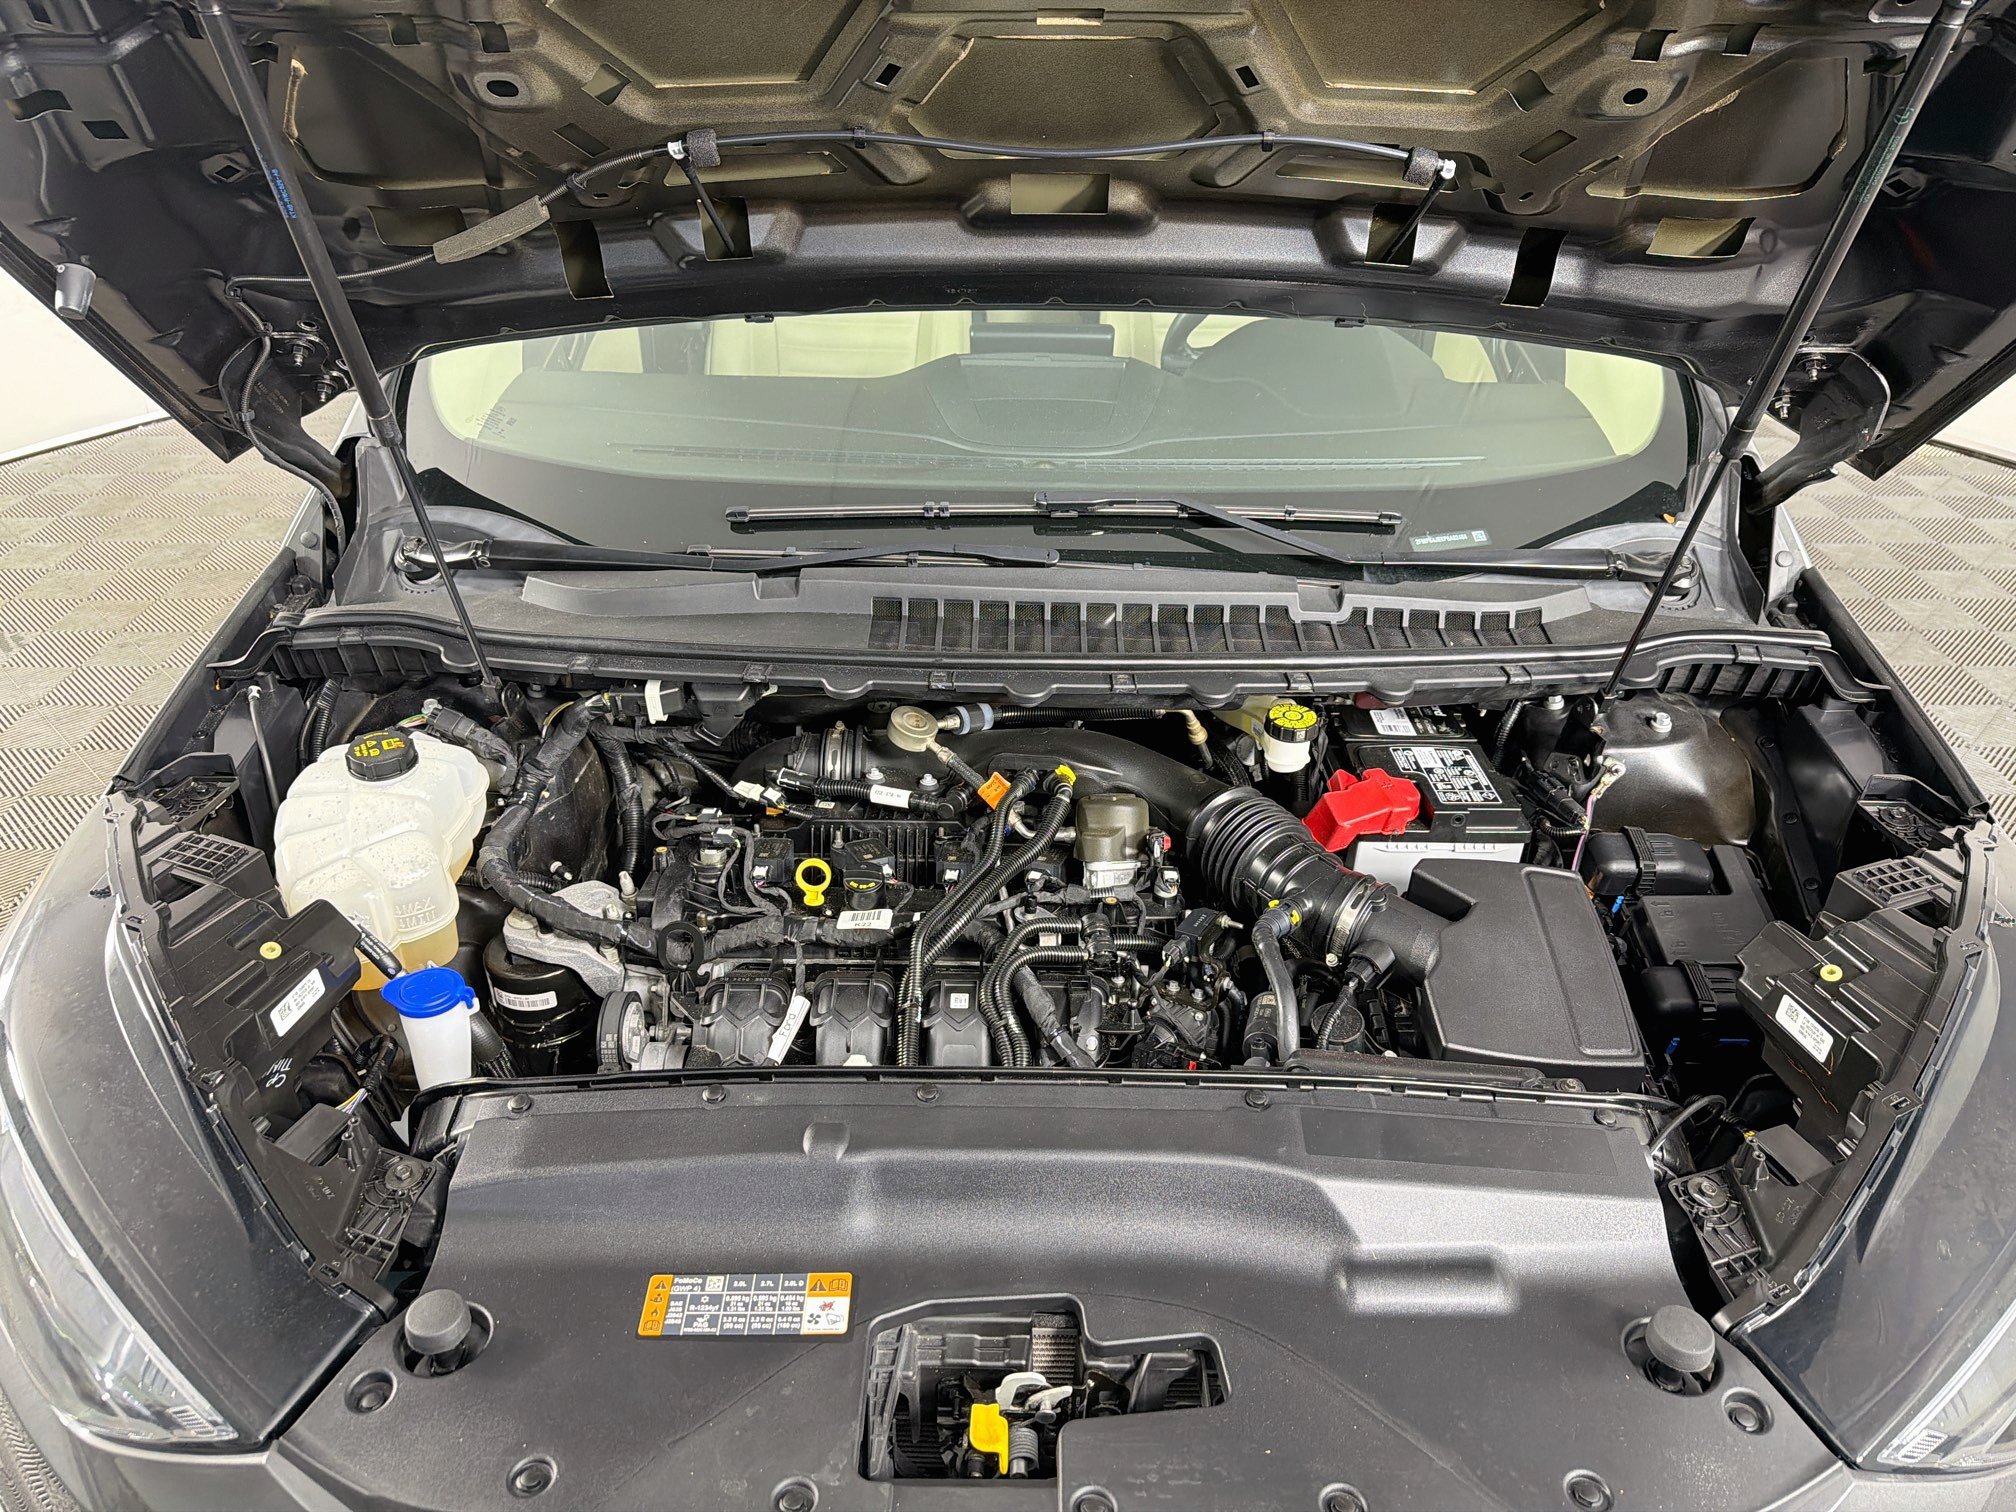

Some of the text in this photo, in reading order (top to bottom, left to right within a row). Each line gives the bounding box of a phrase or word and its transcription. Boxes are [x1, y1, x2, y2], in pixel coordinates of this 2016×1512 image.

[779, 1013, 797, 1037] Ford
[742, 1295, 750, 1303] kg
[769, 1295, 777, 1303] kg
[689, 1304, 720, 1312] R-1234yf
